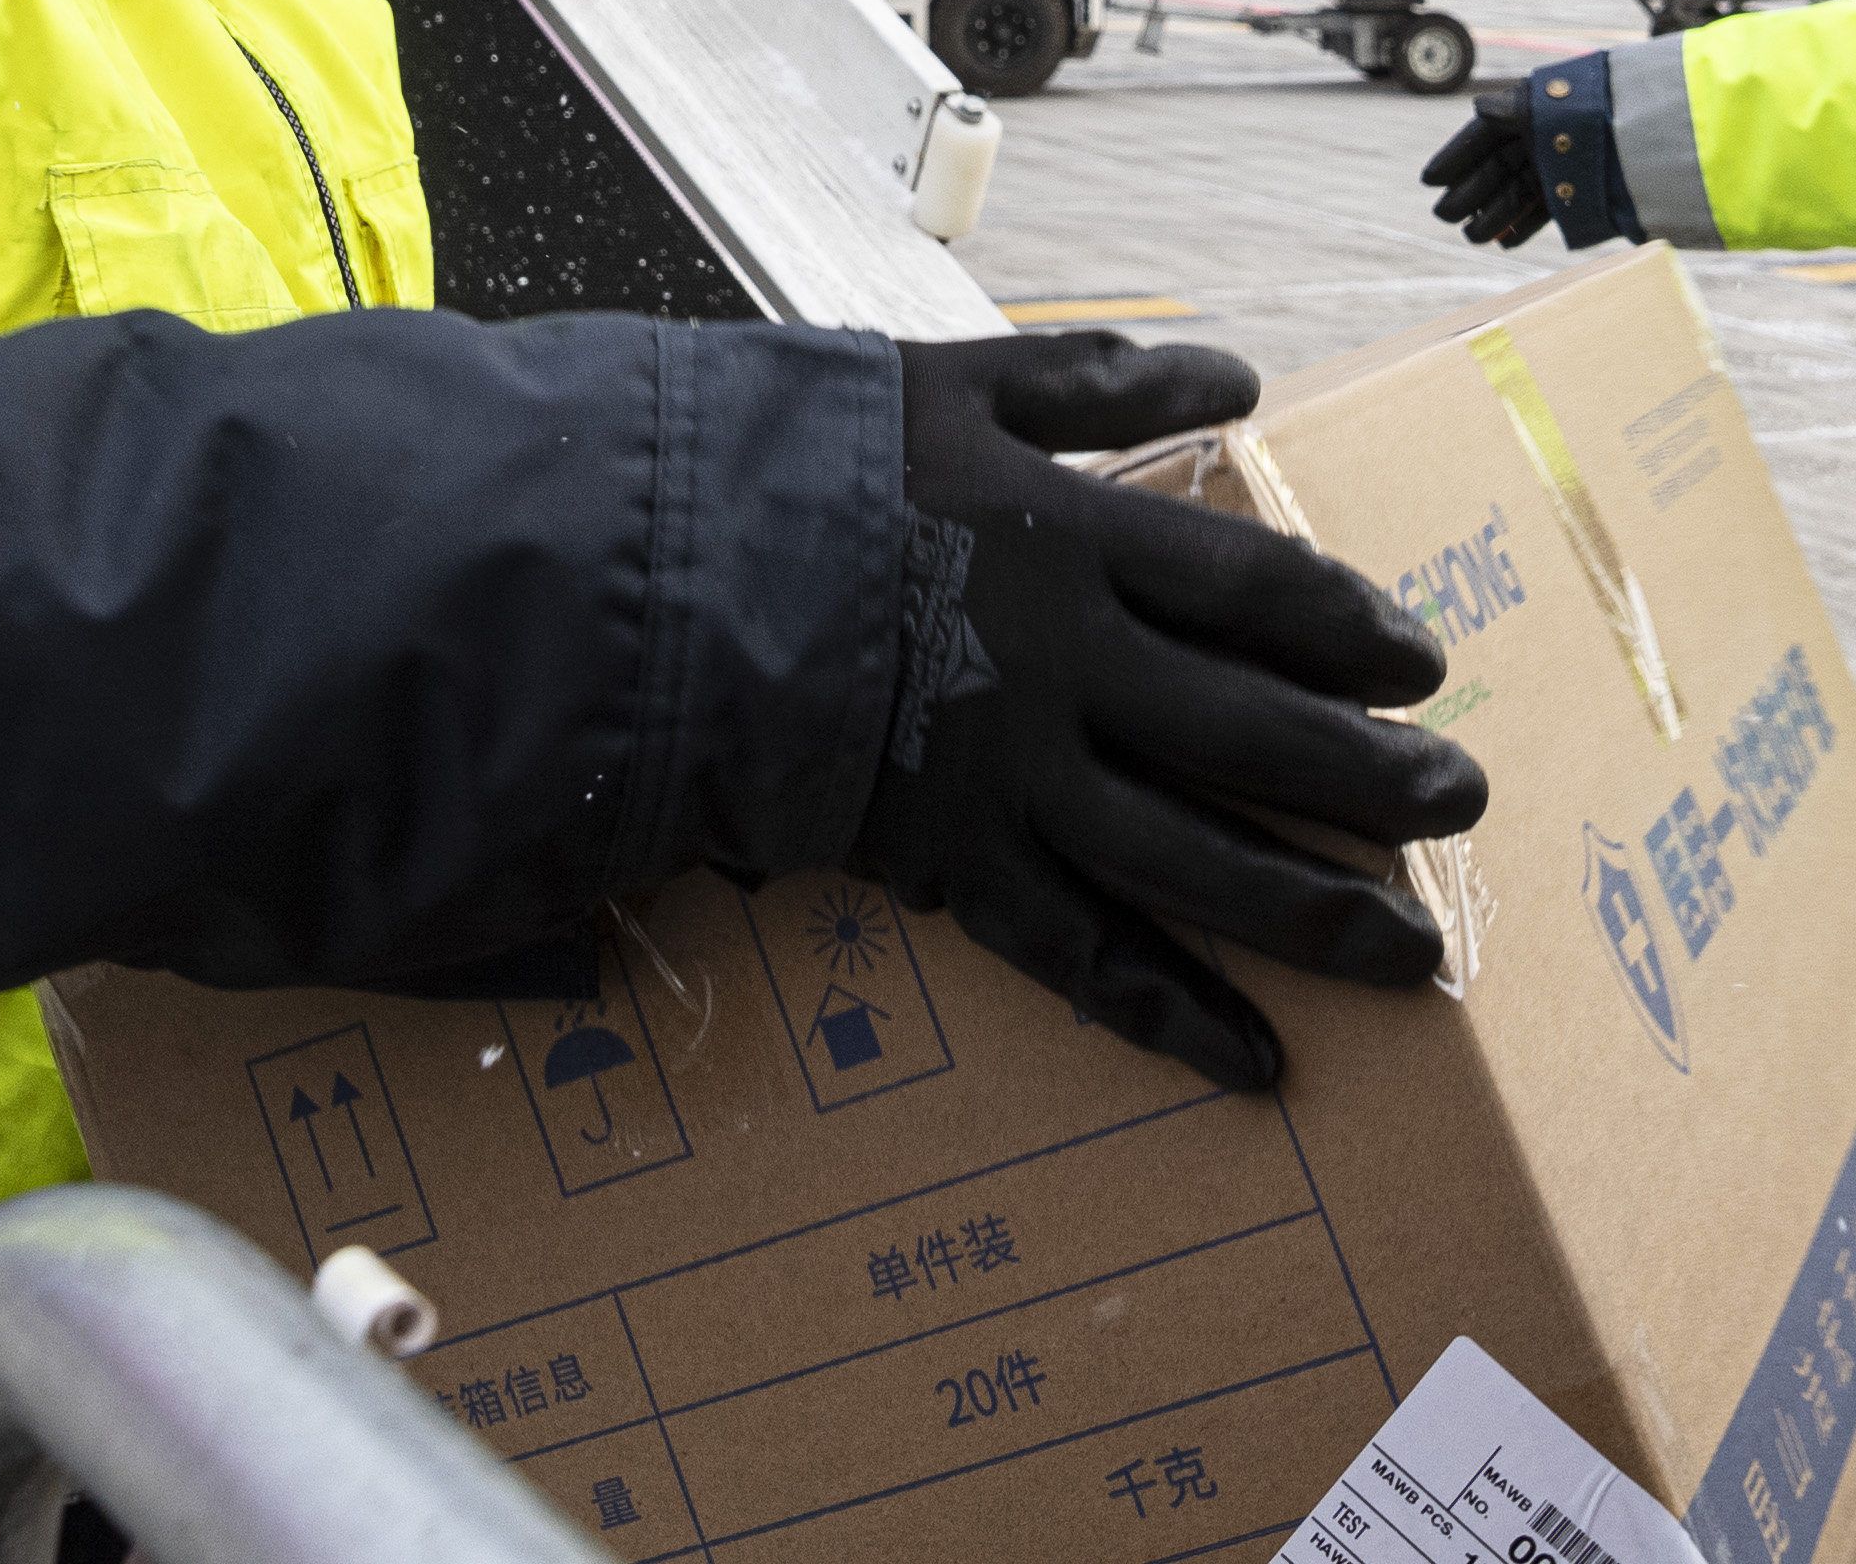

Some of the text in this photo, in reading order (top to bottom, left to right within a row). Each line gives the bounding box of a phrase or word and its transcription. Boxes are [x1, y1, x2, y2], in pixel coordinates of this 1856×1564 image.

[867, 1213, 1022, 1300] 单件装
[935, 1348, 1047, 1429] 20件
[591, 1476, 642, 1531] 量
[1105, 1446, 1218, 1519] 千克
[1371, 1458, 1454, 1541] MAWB PCS.
[1462, 1489, 1490, 1520] NO.
[1483, 1466, 1534, 1513] MAWB
[1309, 1532, 1356, 1564] HAW
[1331, 1501, 1372, 1541] TEST
